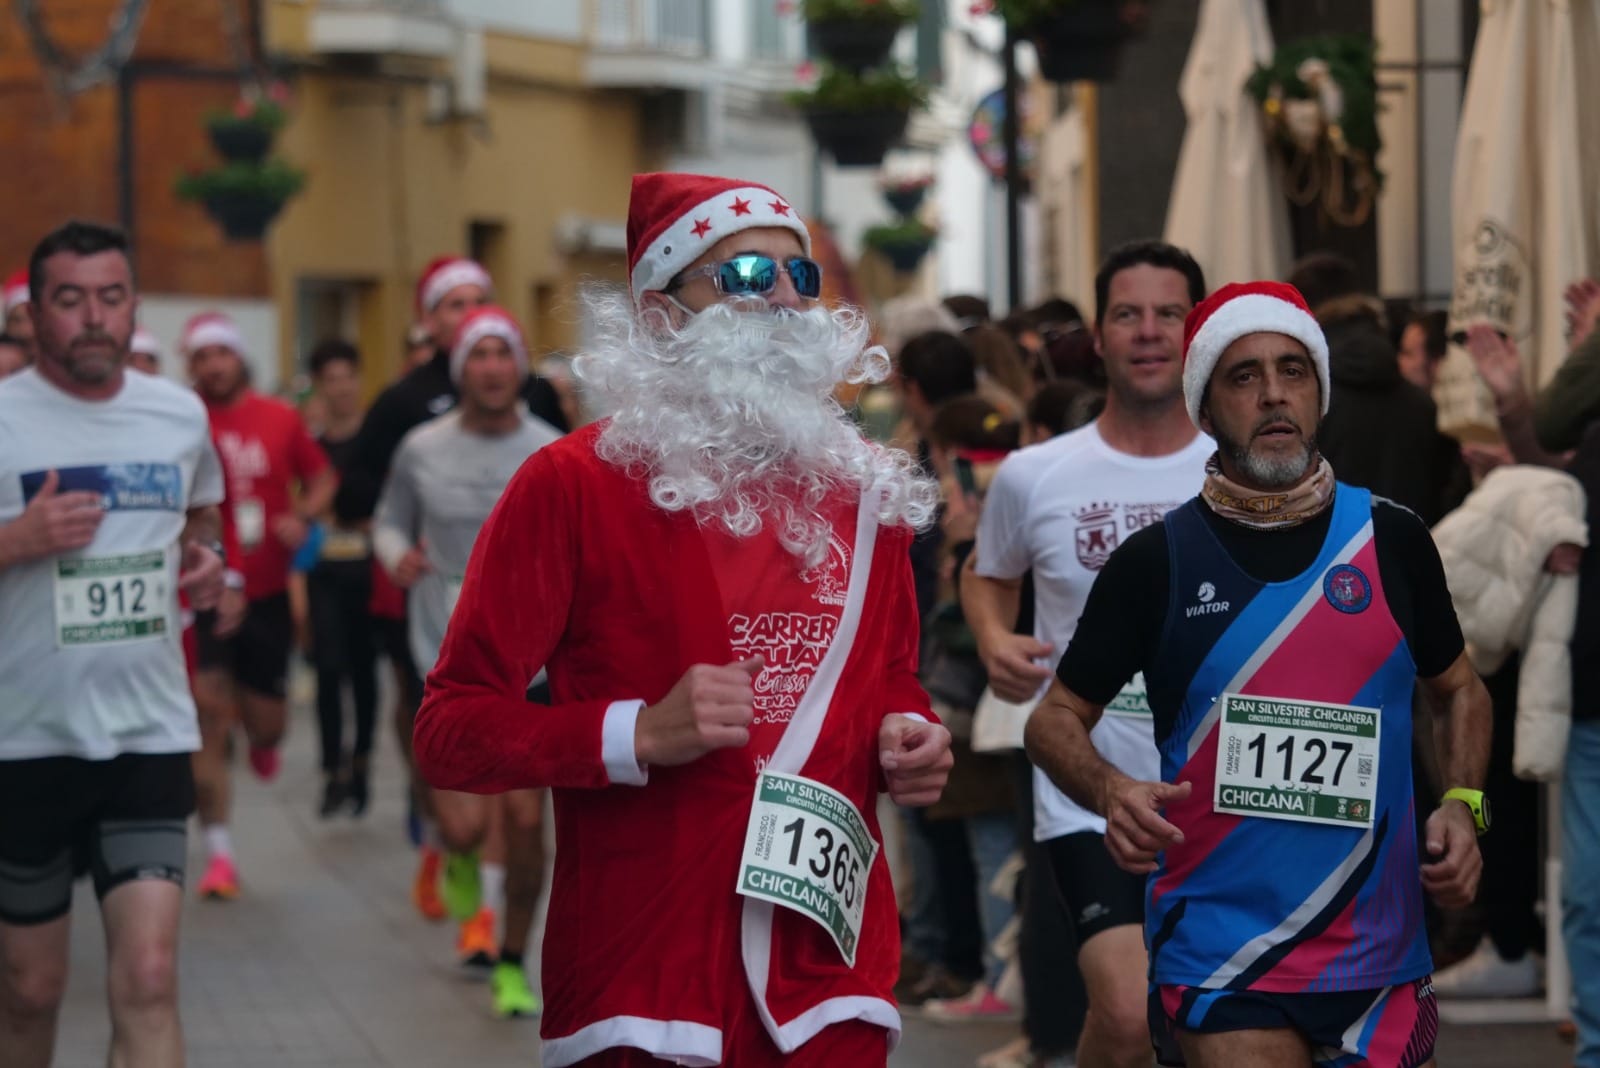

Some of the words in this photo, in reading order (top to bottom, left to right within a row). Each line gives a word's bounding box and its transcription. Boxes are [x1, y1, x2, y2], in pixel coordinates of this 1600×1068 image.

[1125, 512, 1163, 530] DEP
[88, 578, 146, 617] 912
[1186, 601, 1230, 618] VIATOR
[1231, 700, 1256, 713] SAN
[1258, 702, 1311, 718] SILVESTRE
[1313, 708, 1373, 726] CHICLANERA
[1248, 714, 1273, 724] CIRCUITO
[1274, 717, 1292, 726] LOCAL
[1292, 719, 1301, 727] DE
[1330, 723, 1358, 733] POPULARES
[1225, 736, 1236, 776] FRANCISCO
[1248, 733, 1353, 787] 1127
[767, 778, 795, 793] SAN
[798, 785, 849, 818] SILVESTRE
[786, 795, 815, 811] CIRCUITO
[815, 803, 831, 818] LOCAL
[1222, 789, 1304, 811] CHICLANA
[755, 815, 770, 857] FRANCISCO
[783, 816, 859, 910] 1365
[748, 871, 830, 917] CHICLANA
